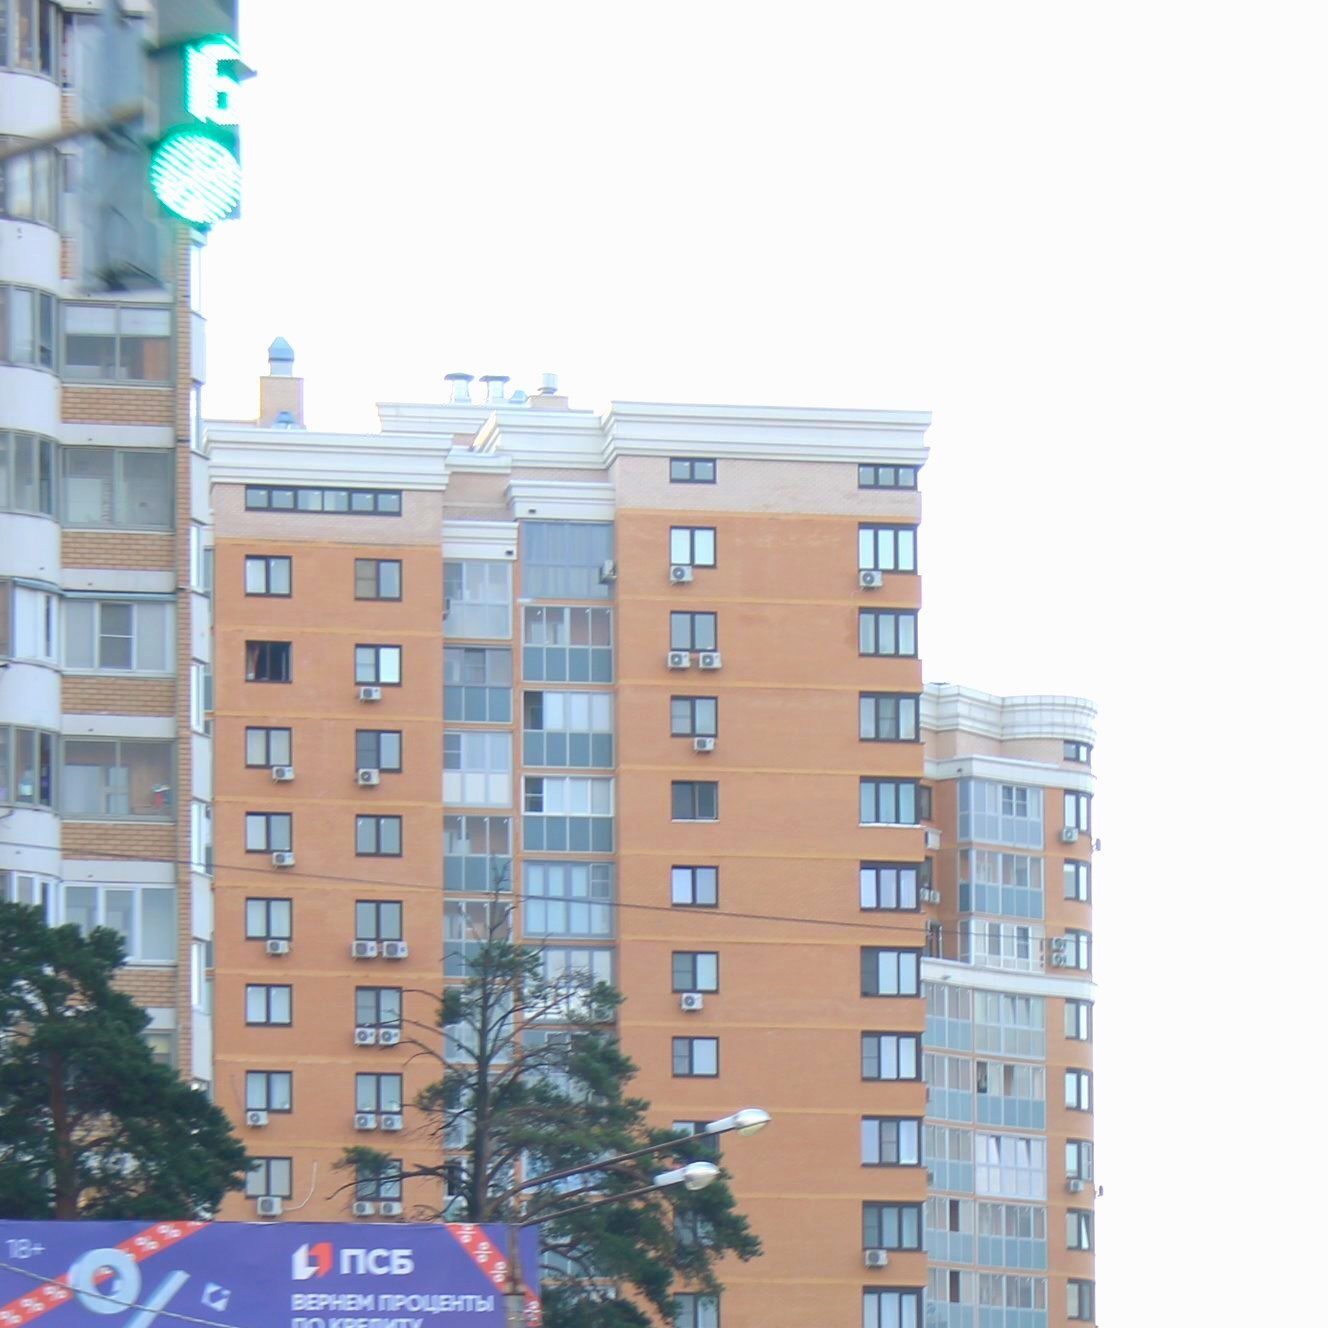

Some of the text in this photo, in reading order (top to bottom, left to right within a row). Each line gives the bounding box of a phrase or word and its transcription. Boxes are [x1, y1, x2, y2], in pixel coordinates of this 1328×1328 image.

[5, 1238, 46, 1259] 18+
[339, 1248, 415, 1275] ПСБ
[291, 1293, 495, 1315] ВЕРНЕМ ПРОЦЕНТЫ
